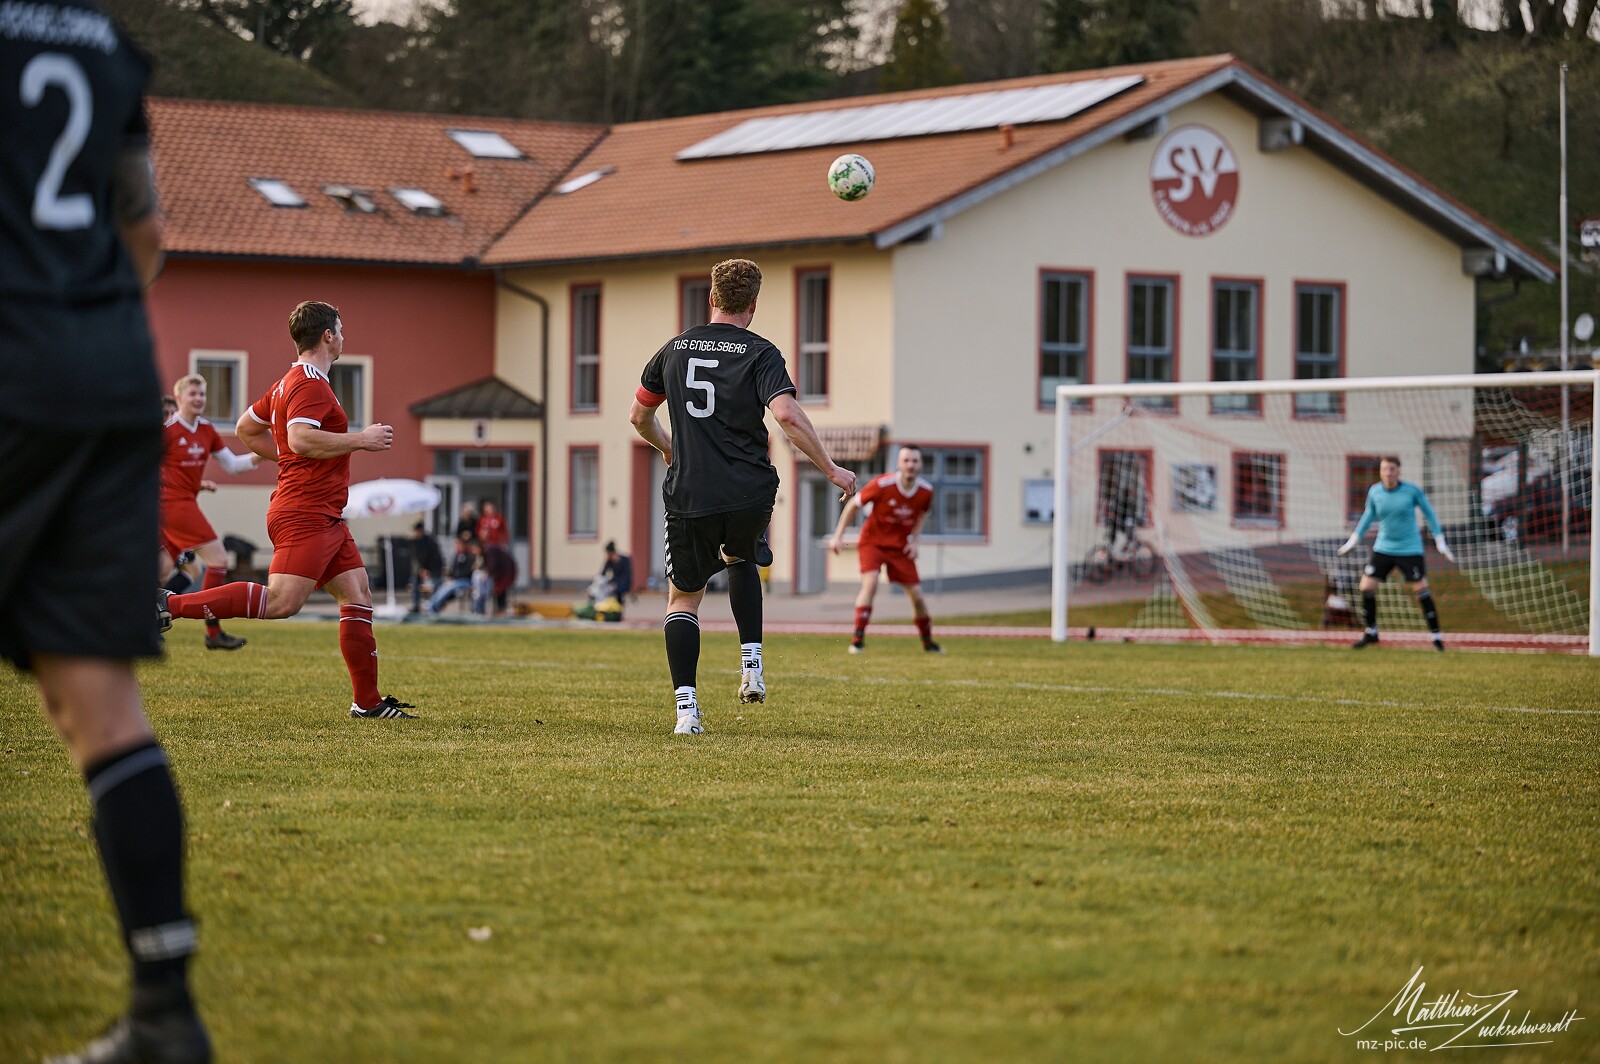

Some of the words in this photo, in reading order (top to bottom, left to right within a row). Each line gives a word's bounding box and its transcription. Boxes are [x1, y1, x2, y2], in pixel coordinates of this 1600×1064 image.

[20, 52, 95, 230] 2
[1168, 146, 1224, 203] SV
[673, 339, 689, 351] TUS
[689, 340, 748, 354] ENGELSBERG
[686, 357, 720, 418] 5
